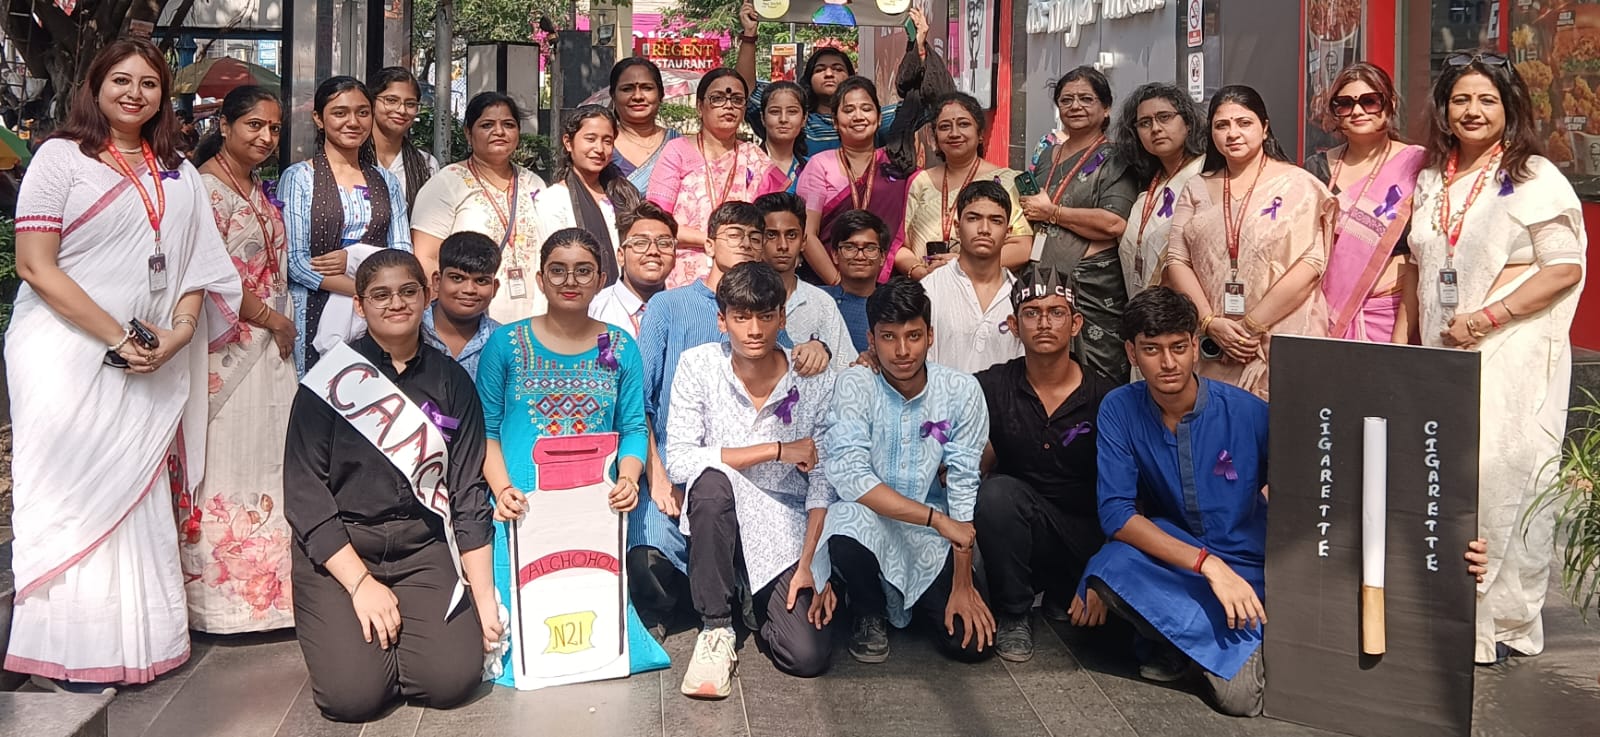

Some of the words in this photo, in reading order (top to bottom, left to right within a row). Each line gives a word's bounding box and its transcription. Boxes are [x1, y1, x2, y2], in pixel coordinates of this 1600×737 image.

[650, 59, 713, 69] STAURANT
[652, 43, 713, 57] REGENT
[1317, 408, 1333, 557] CIGARETTE
[1424, 421, 1441, 572] CIGARETTE
[528, 552, 619, 580] ALCHOHOL
